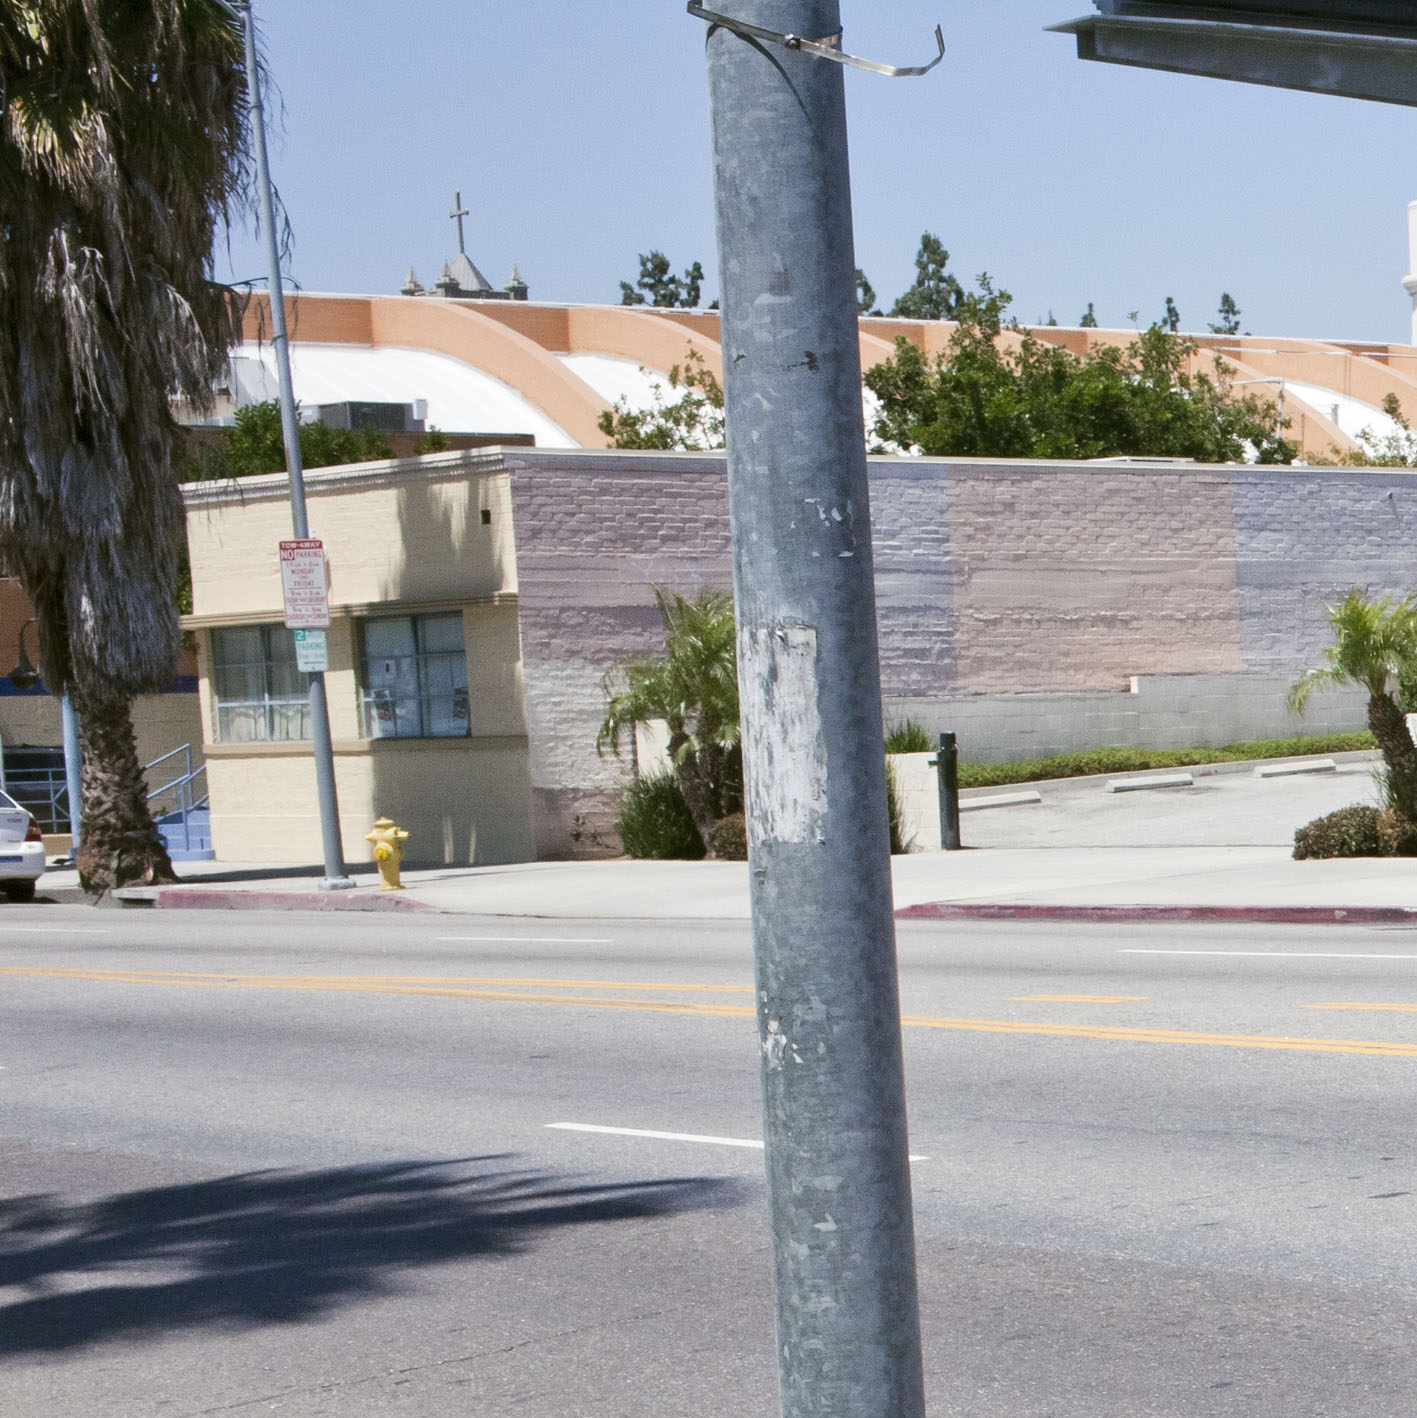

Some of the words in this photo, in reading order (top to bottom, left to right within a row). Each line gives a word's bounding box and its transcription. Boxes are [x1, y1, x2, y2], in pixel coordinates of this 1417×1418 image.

[281, 541, 321, 549] TOW-AWAY
[280, 550, 294, 560] NO
[295, 550, 322, 558] PARKING
[296, 630, 304, 640] 2
